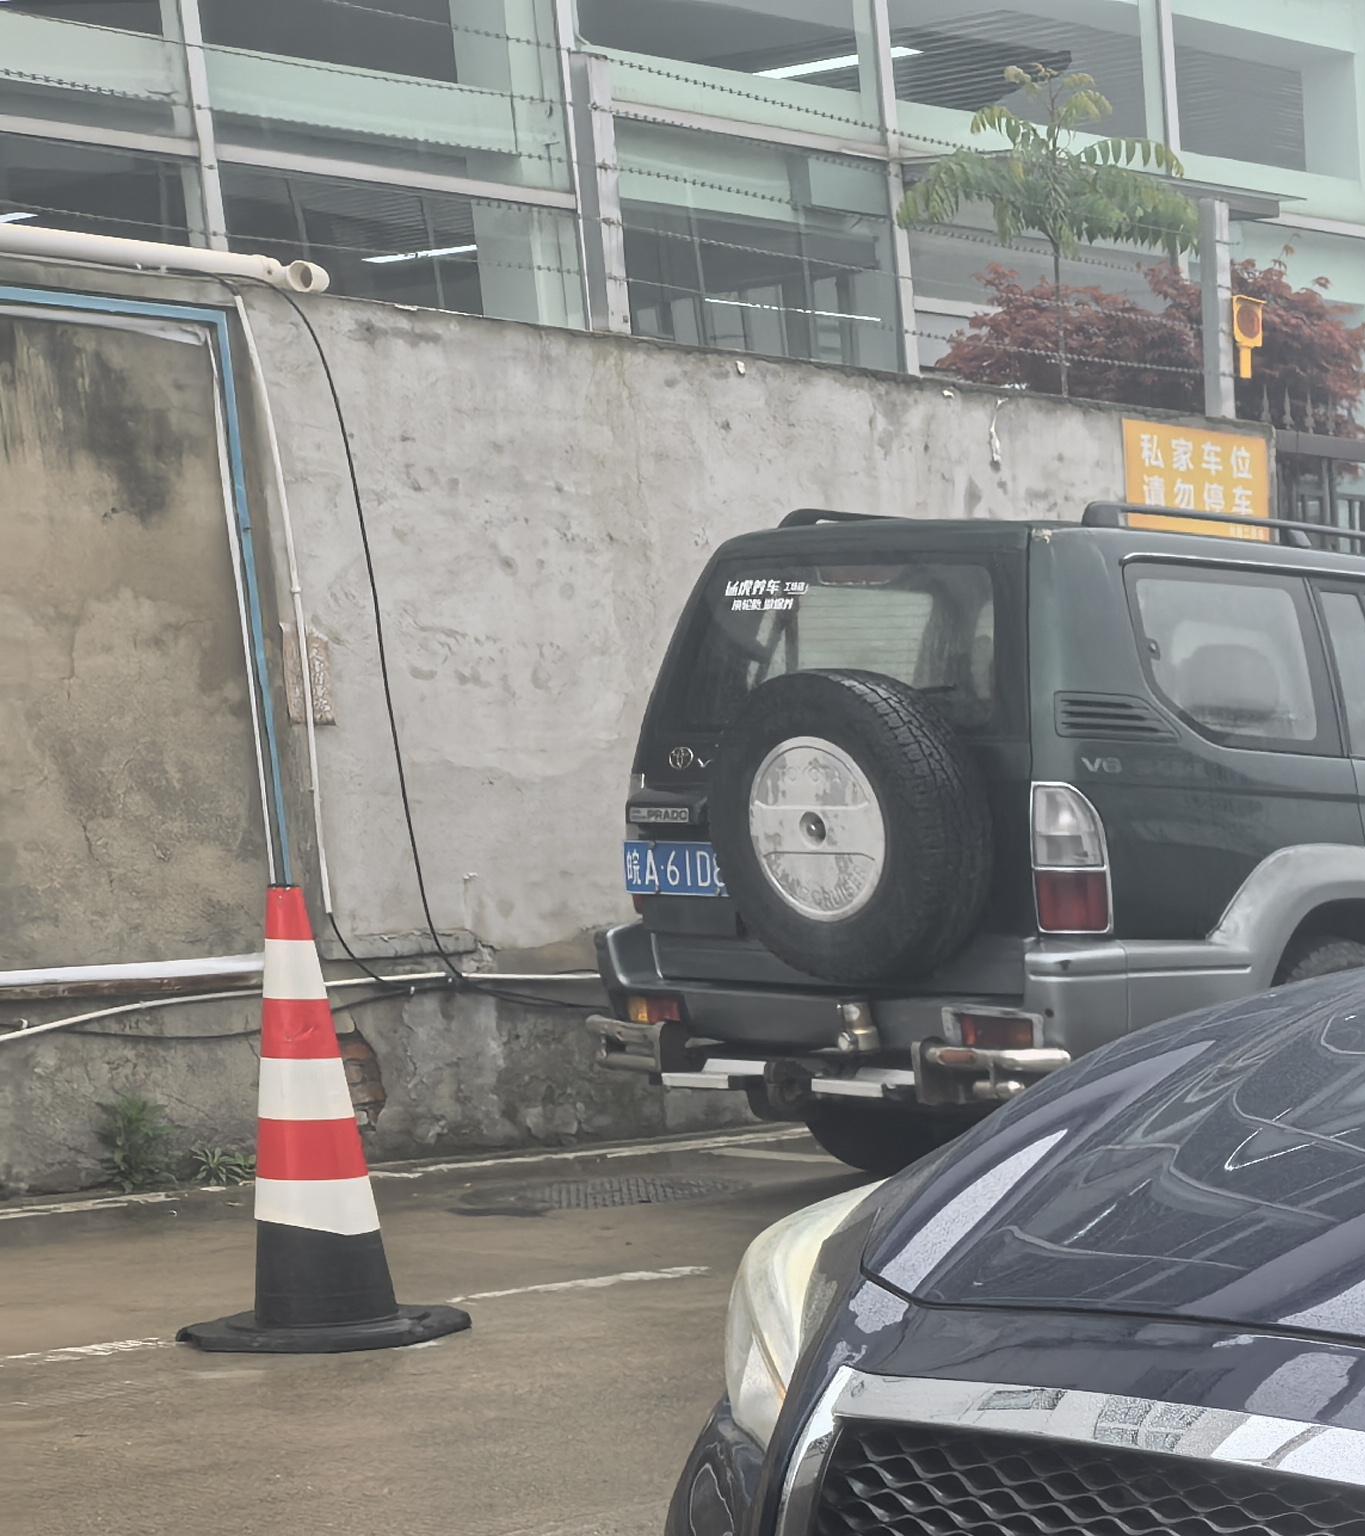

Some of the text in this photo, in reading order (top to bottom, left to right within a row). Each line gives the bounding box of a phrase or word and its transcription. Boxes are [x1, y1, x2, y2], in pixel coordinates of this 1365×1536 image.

[1139, 433, 1253, 480] 私家车位
[647, 809, 688, 821] PRADO
